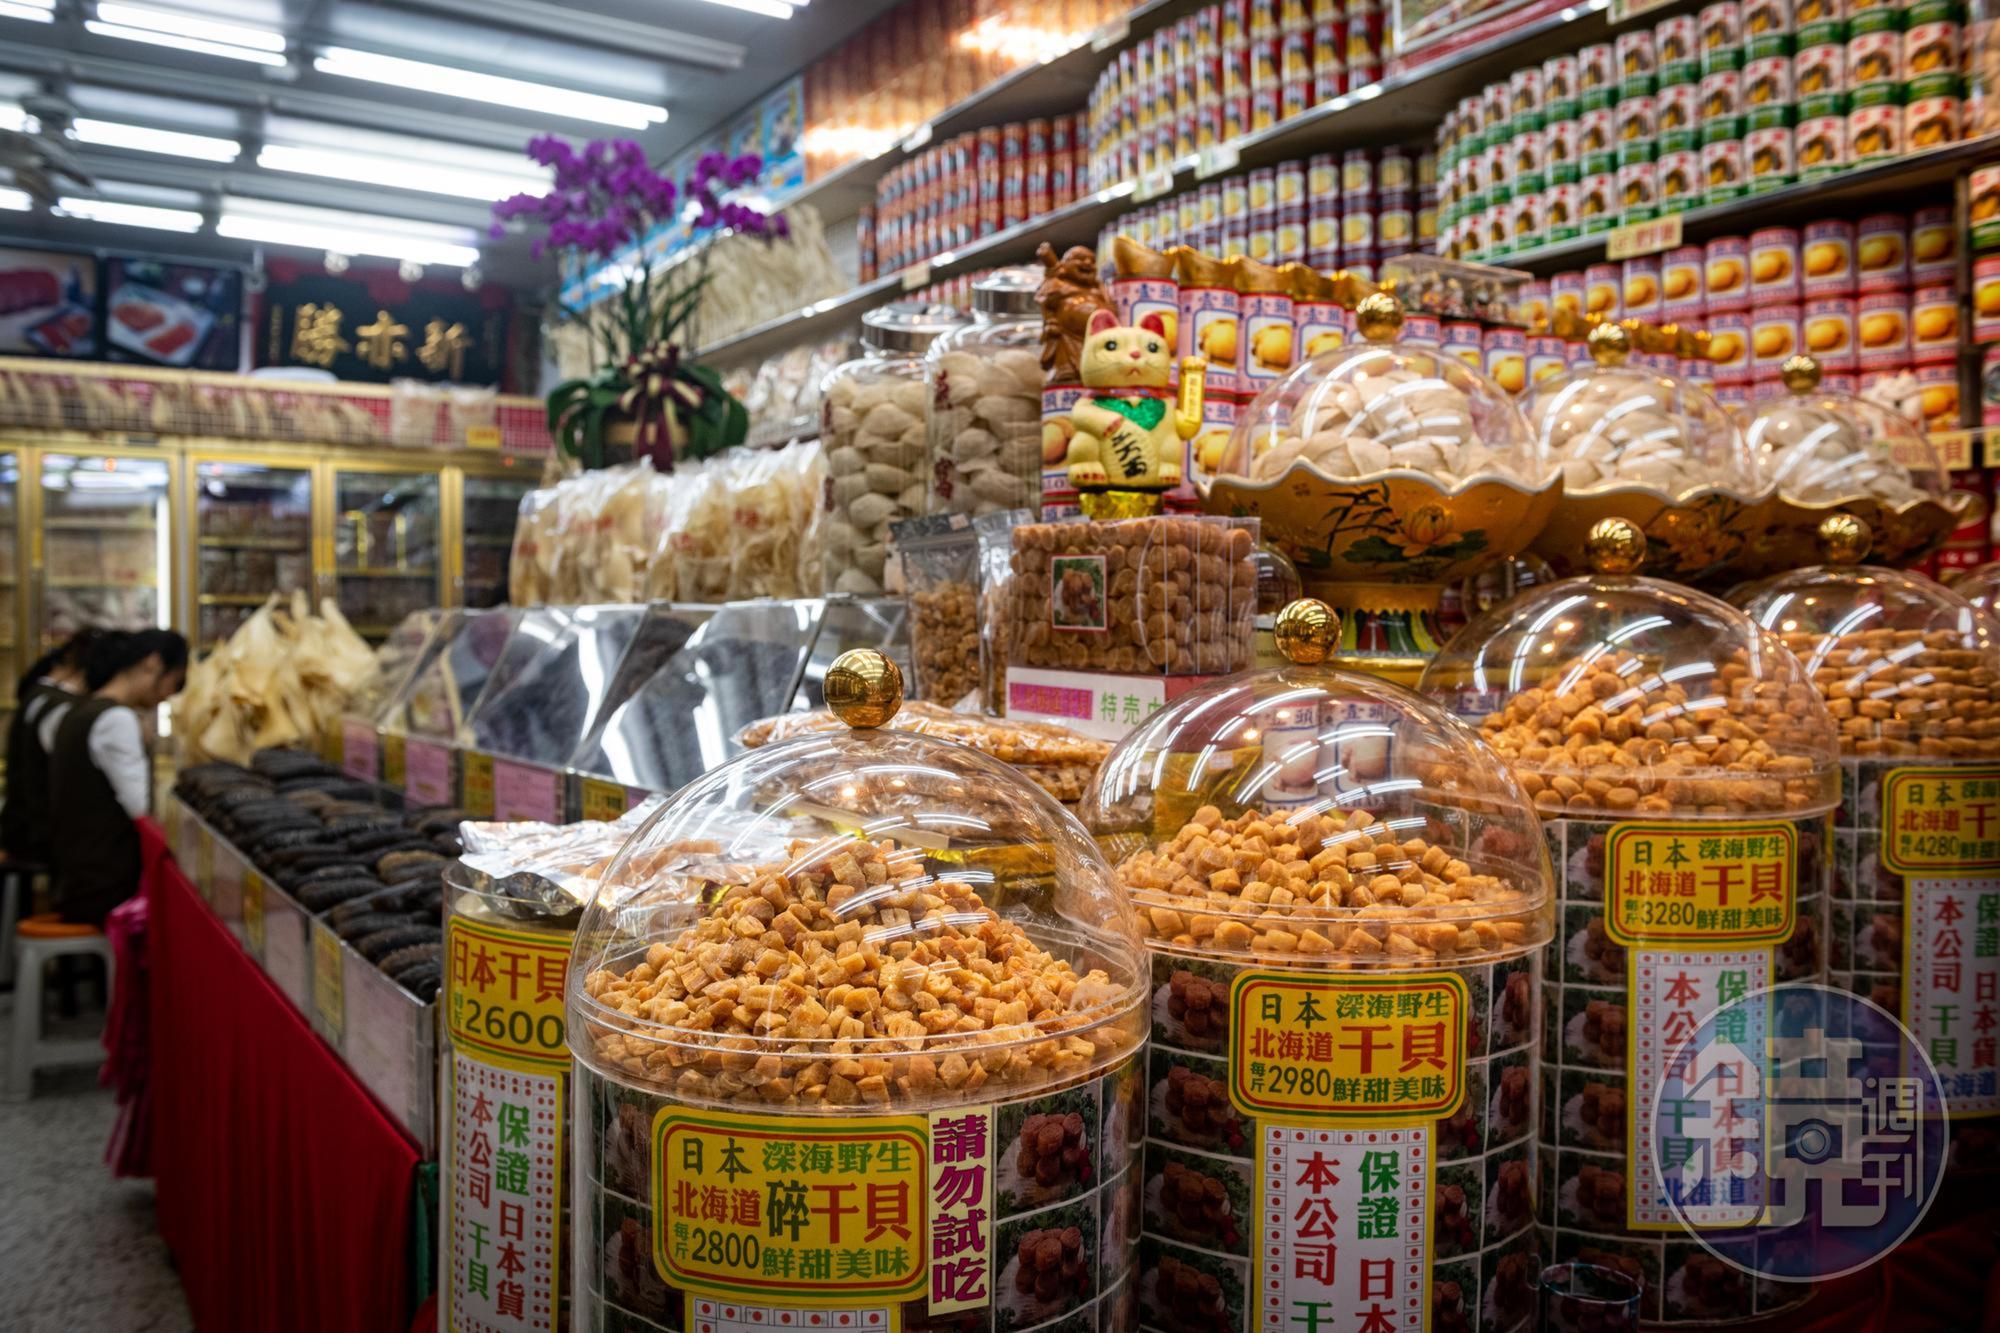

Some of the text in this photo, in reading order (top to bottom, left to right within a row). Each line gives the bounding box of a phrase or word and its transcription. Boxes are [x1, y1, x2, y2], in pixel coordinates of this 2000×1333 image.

[1899, 803, 1997, 839] 北海道 干
[1907, 781, 1956, 807] 日本
[1633, 835, 1786, 870] 日本 深海野生
[1914, 836, 1959, 857] 4280
[1624, 860, 1784, 906] 北海道 干貝
[1640, 901, 1696, 926] 3280
[1696, 905, 1783, 931] 鮮甜美味
[453, 936, 570, 1005] 日本干貝
[1929, 893, 1966, 1069] 本公司 干貝
[465, 998, 564, 1049] 2600
[1261, 991, 1450, 1030] 日本 深海野生
[1971, 970, 1999, 1069] 日本貨
[1249, 1021, 1449, 1075] 北海道 干貝
[1659, 970, 1702, 1173] 本公司 干貝
[1712, 969, 1748, 1175] 保證 日本貨
[1267, 1064, 1332, 1097] 2980
[1332, 1074, 1446, 1103] 鮮甜美味
[681, 1136, 912, 1184] 日本 深海野生
[466, 1090, 493, 1301] 本公司 干貝
[495, 1101, 531, 1322] 保證 日本貨
[671, 1179, 913, 1245] 北海道 碎干貝
[932, 1113, 989, 1305] 請勿試吃
[1293, 1150, 1341, 1287] 本公司
[1357, 1150, 1400, 1240] 保證
[690, 1226, 760, 1270] 2800
[761, 1246, 912, 1281] 鮮甜美味
